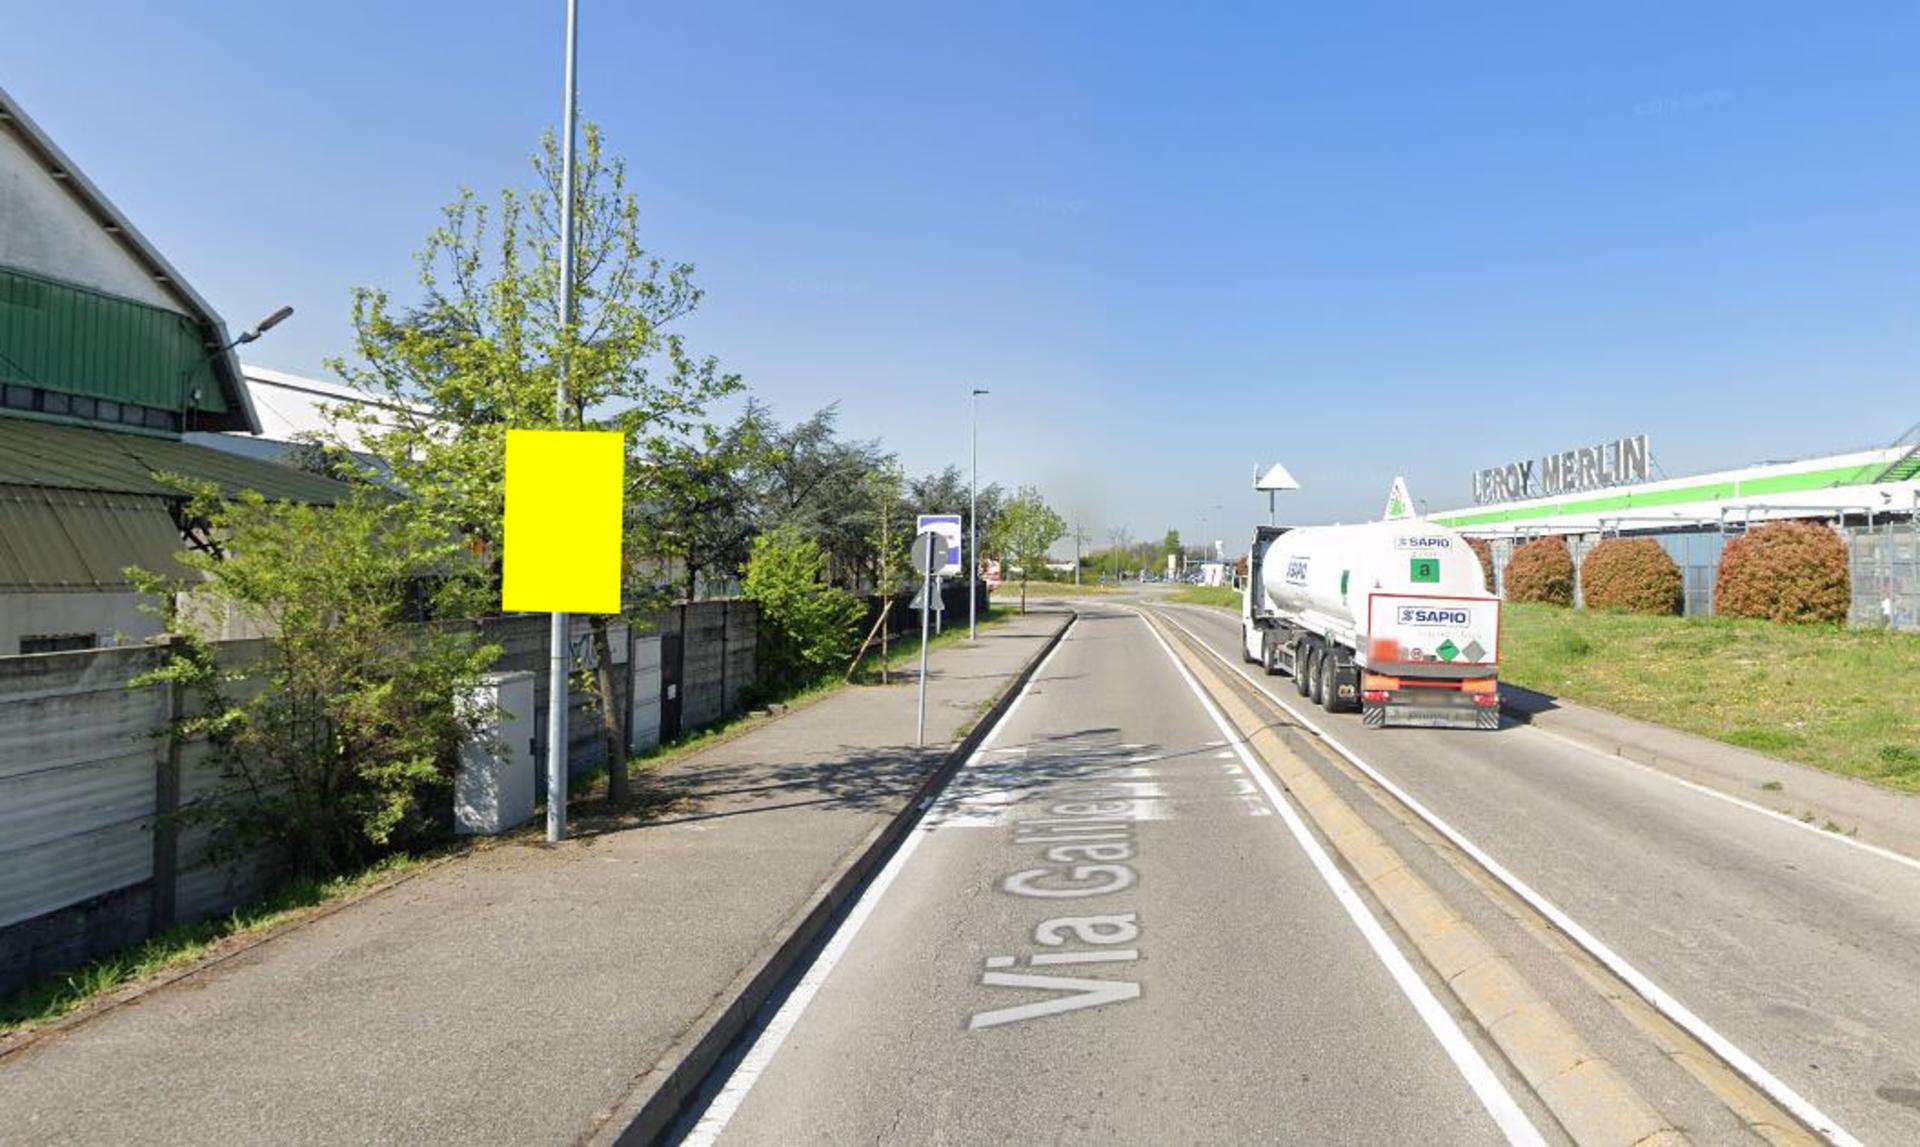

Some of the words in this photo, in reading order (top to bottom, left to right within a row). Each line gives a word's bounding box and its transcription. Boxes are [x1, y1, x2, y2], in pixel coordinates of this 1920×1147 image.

[1473, 460, 1534, 505] LEROY
[1542, 434, 1649, 494] MERLIN
[1409, 538, 1449, 548] SAPIO
[1415, 611, 1466, 624] SAPIO
